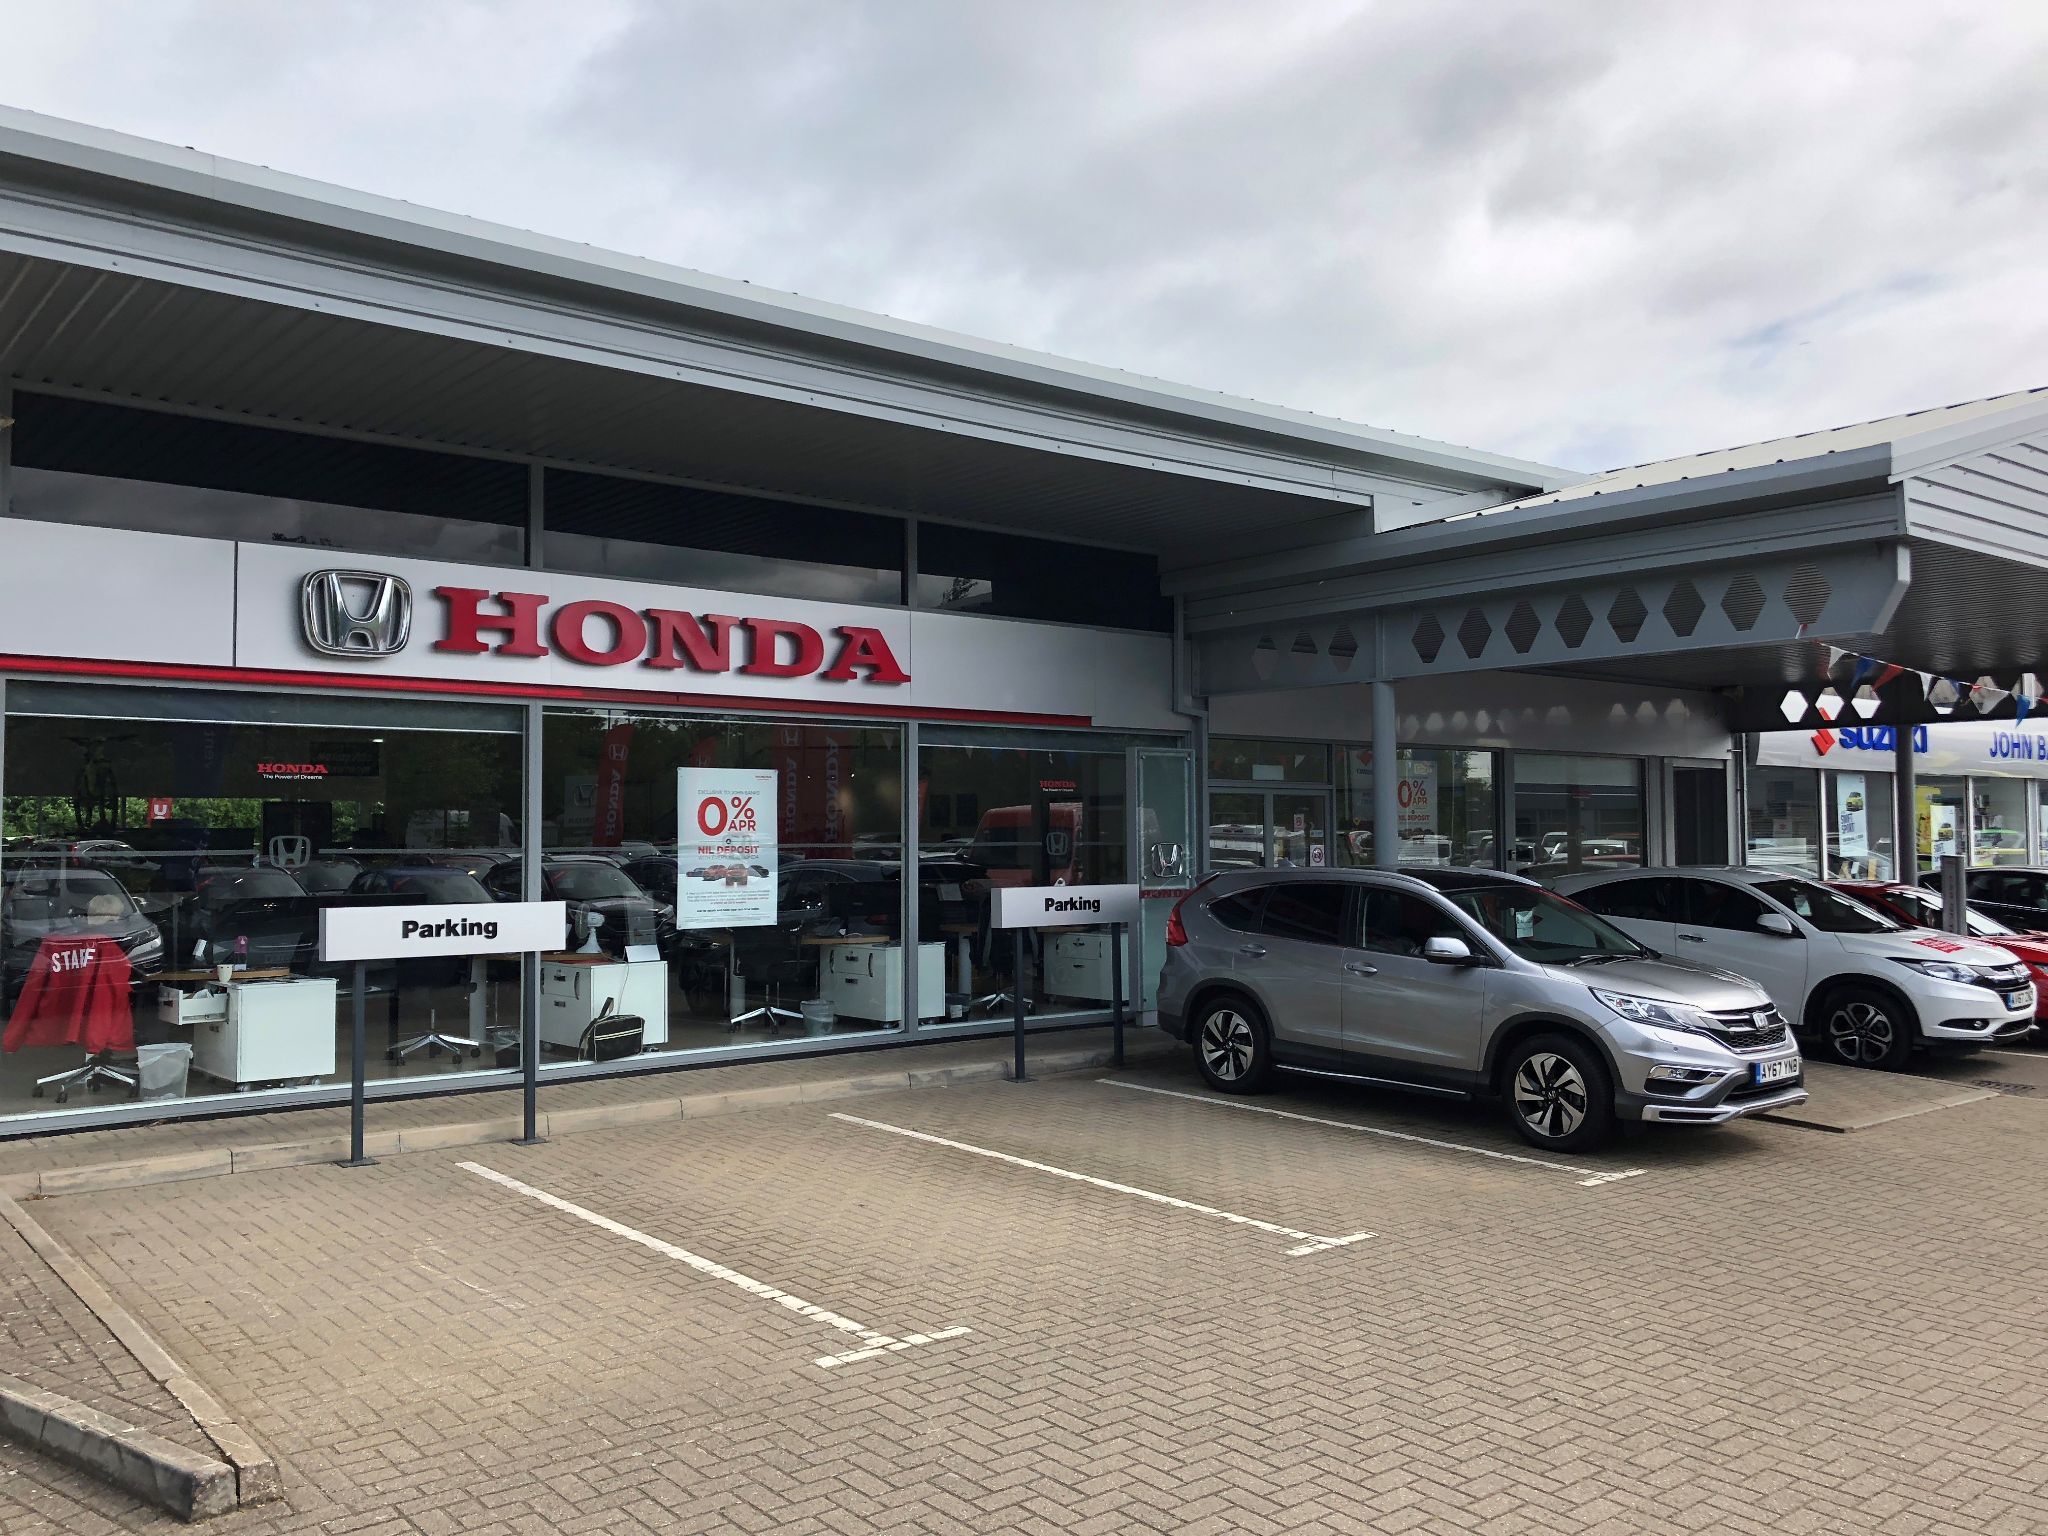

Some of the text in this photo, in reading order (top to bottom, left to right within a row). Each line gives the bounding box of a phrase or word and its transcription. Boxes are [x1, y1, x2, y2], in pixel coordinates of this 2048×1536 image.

[434, 585, 912, 684] HONDA
[1839, 725, 1928, 753] SUZKI
[1989, 731, 2048, 761] JOHN B
[257, 763, 329, 774] HONDA
[697, 796, 755, 837] 0%
[727, 819, 757, 832] APR
[697, 845, 760, 855] NIL DEPOSIT
[1044, 896, 1101, 913] Parking
[401, 918, 498, 940] Parking
[51, 948, 96, 973] STAFF
[1761, 1060, 1782, 1080] AY67
